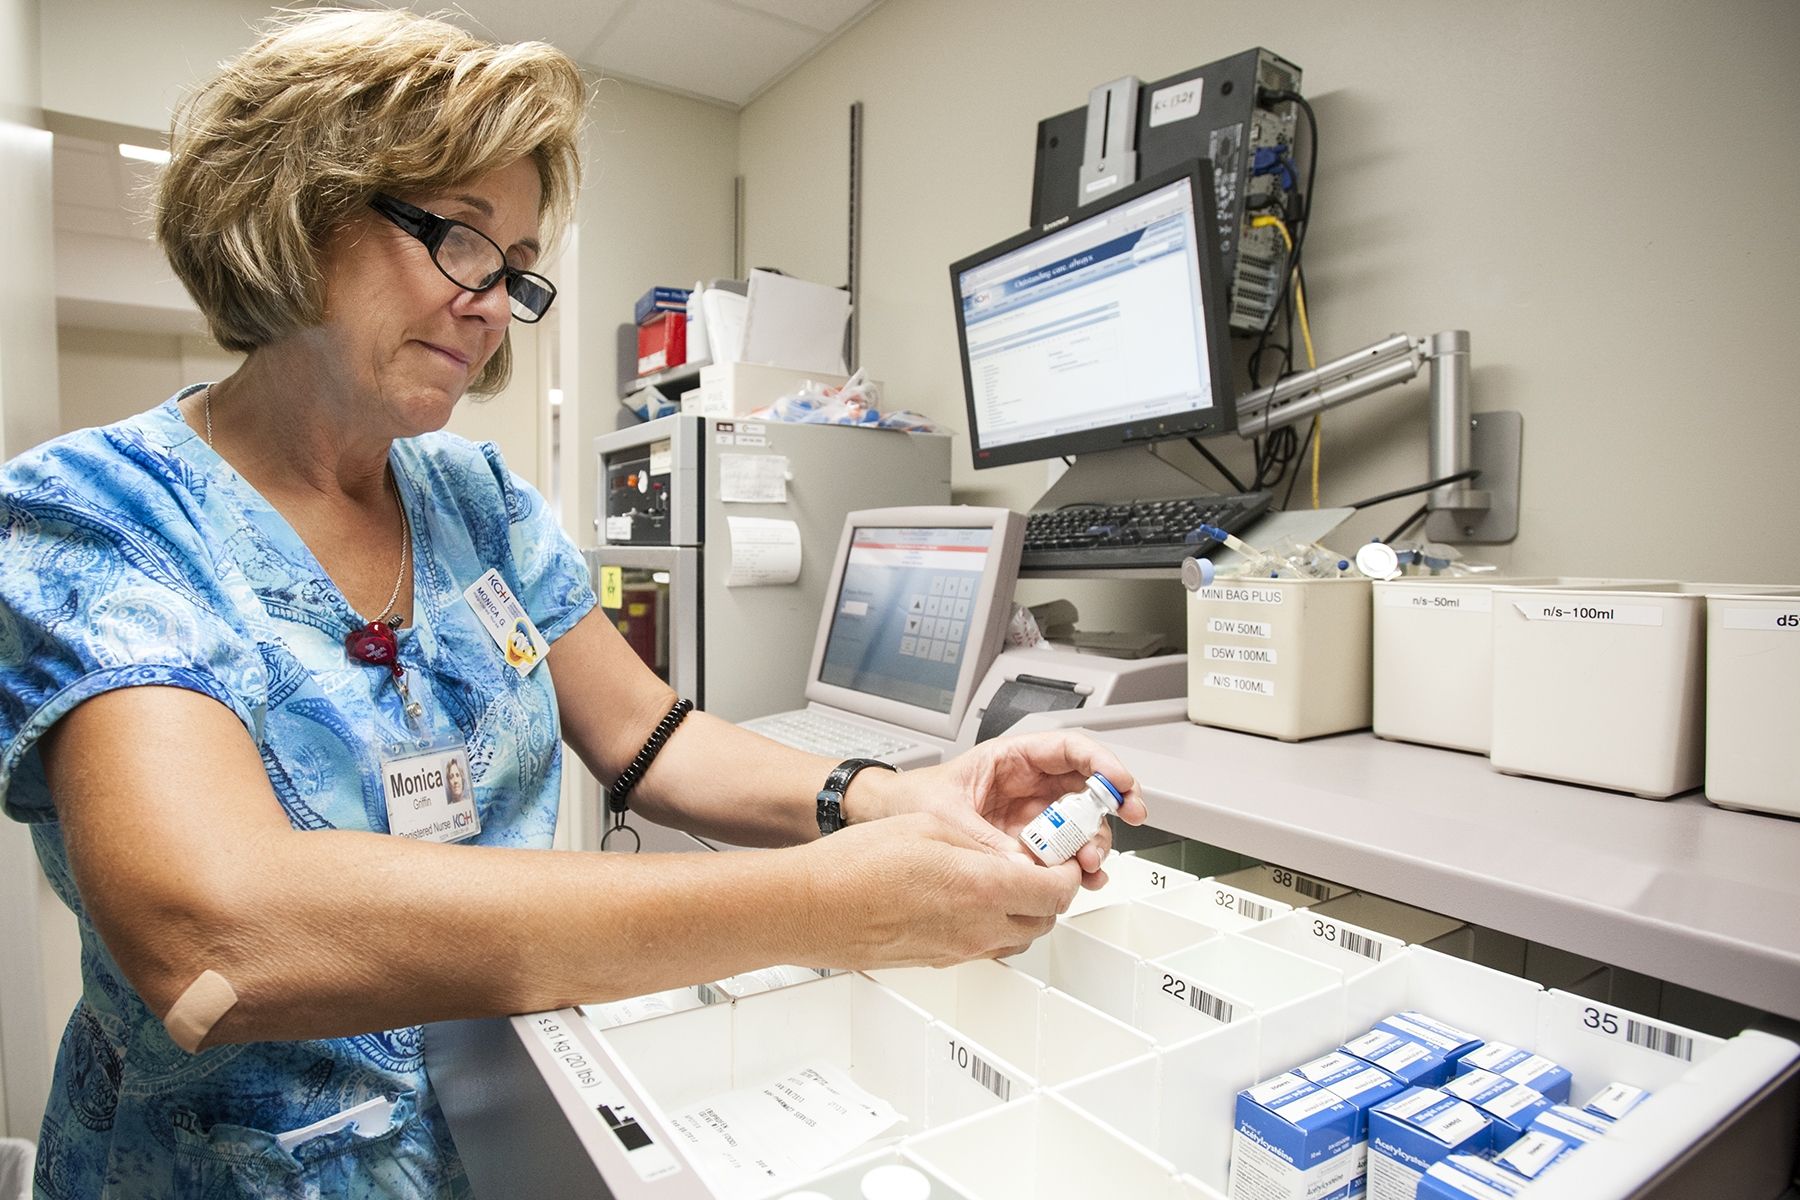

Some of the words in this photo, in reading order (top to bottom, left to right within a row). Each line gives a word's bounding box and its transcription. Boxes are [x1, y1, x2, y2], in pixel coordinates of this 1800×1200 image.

[476, 586, 499, 619] MONICA
[1201, 588, 1223, 600] MINI
[1226, 589, 1249, 601] BAG
[1252, 590, 1282, 602] PLUS
[1412, 597, 1460, 607] n/s-50ml
[1543, 606, 1614, 620] n/s-100ml
[1776, 613, 1800, 627] d5
[1214, 621, 1235, 633] D/W
[1237, 624, 1265, 636] 50ML
[1211, 647, 1235, 659] D5W
[1238, 649, 1271, 662] 100ML
[1213, 675, 1231, 687] N/S
[1234, 678, 1267, 693] 100ML
[390, 768, 443, 798] Monica
[413, 796, 432, 811] Griffin
[432, 820, 451, 834] Nurse
[1150, 871, 1167, 889] 31
[1272, 868, 1293, 888] 38
[1215, 890, 1235, 910] 32
[1313, 919, 1337, 942] 33
[1161, 973, 1187, 1001] 22
[1583, 1007, 1619, 1035] 35
[948, 1040, 969, 1069] 10
